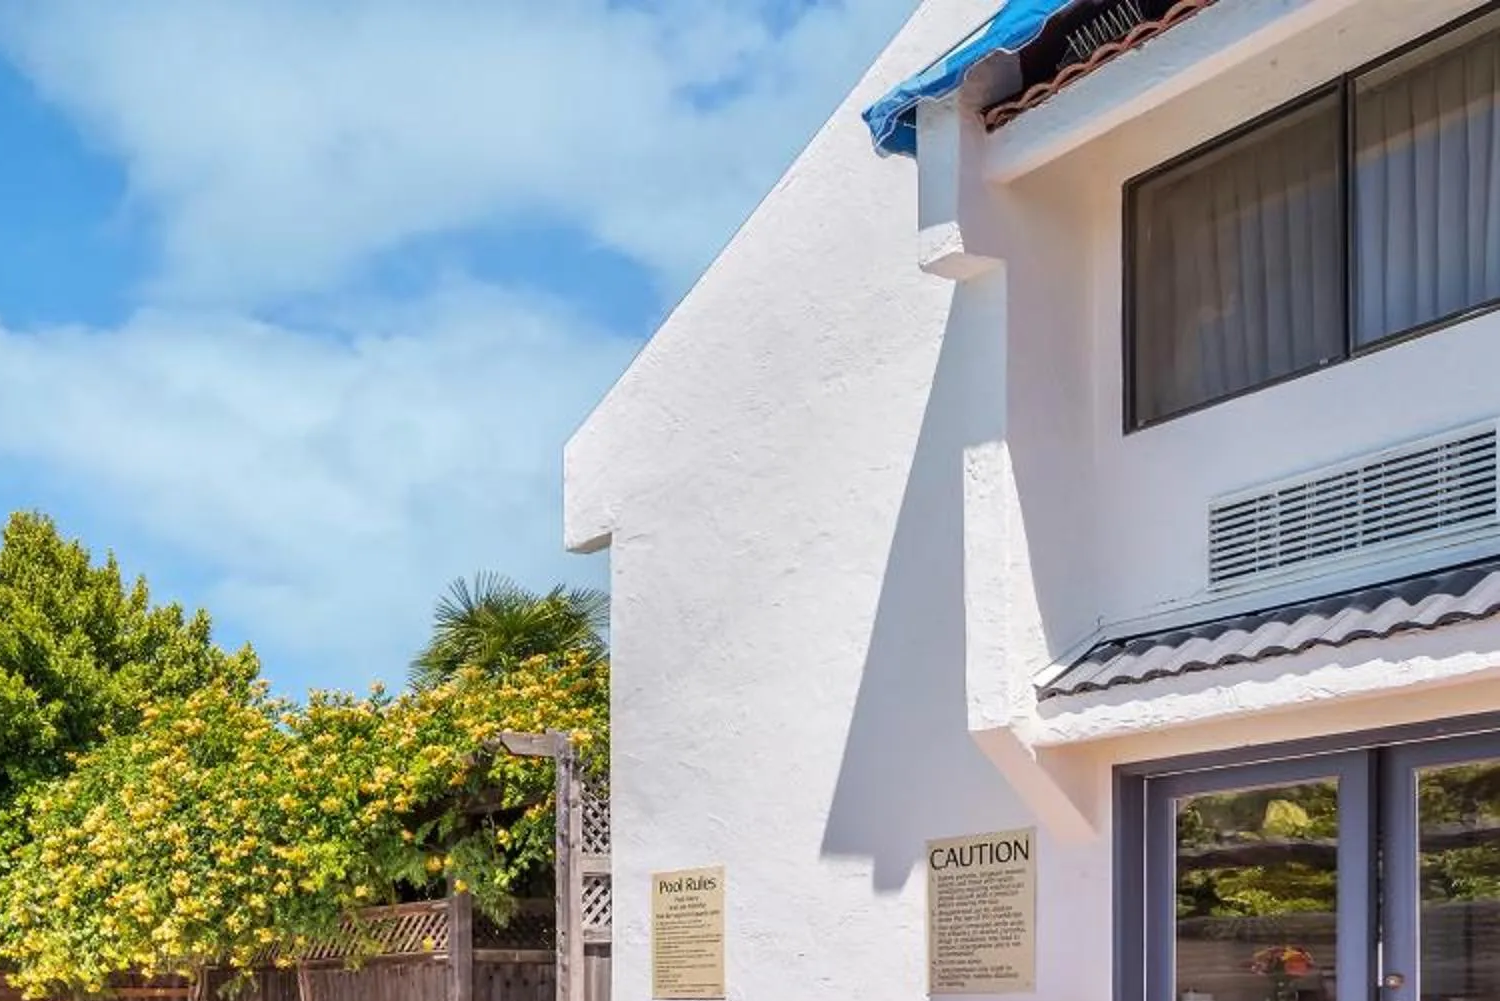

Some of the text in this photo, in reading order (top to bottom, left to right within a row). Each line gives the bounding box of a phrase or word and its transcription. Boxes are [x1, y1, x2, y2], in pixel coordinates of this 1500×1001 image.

[929, 837, 1029, 870] CAUTION
[660, 876, 717, 895] Pool Rules
